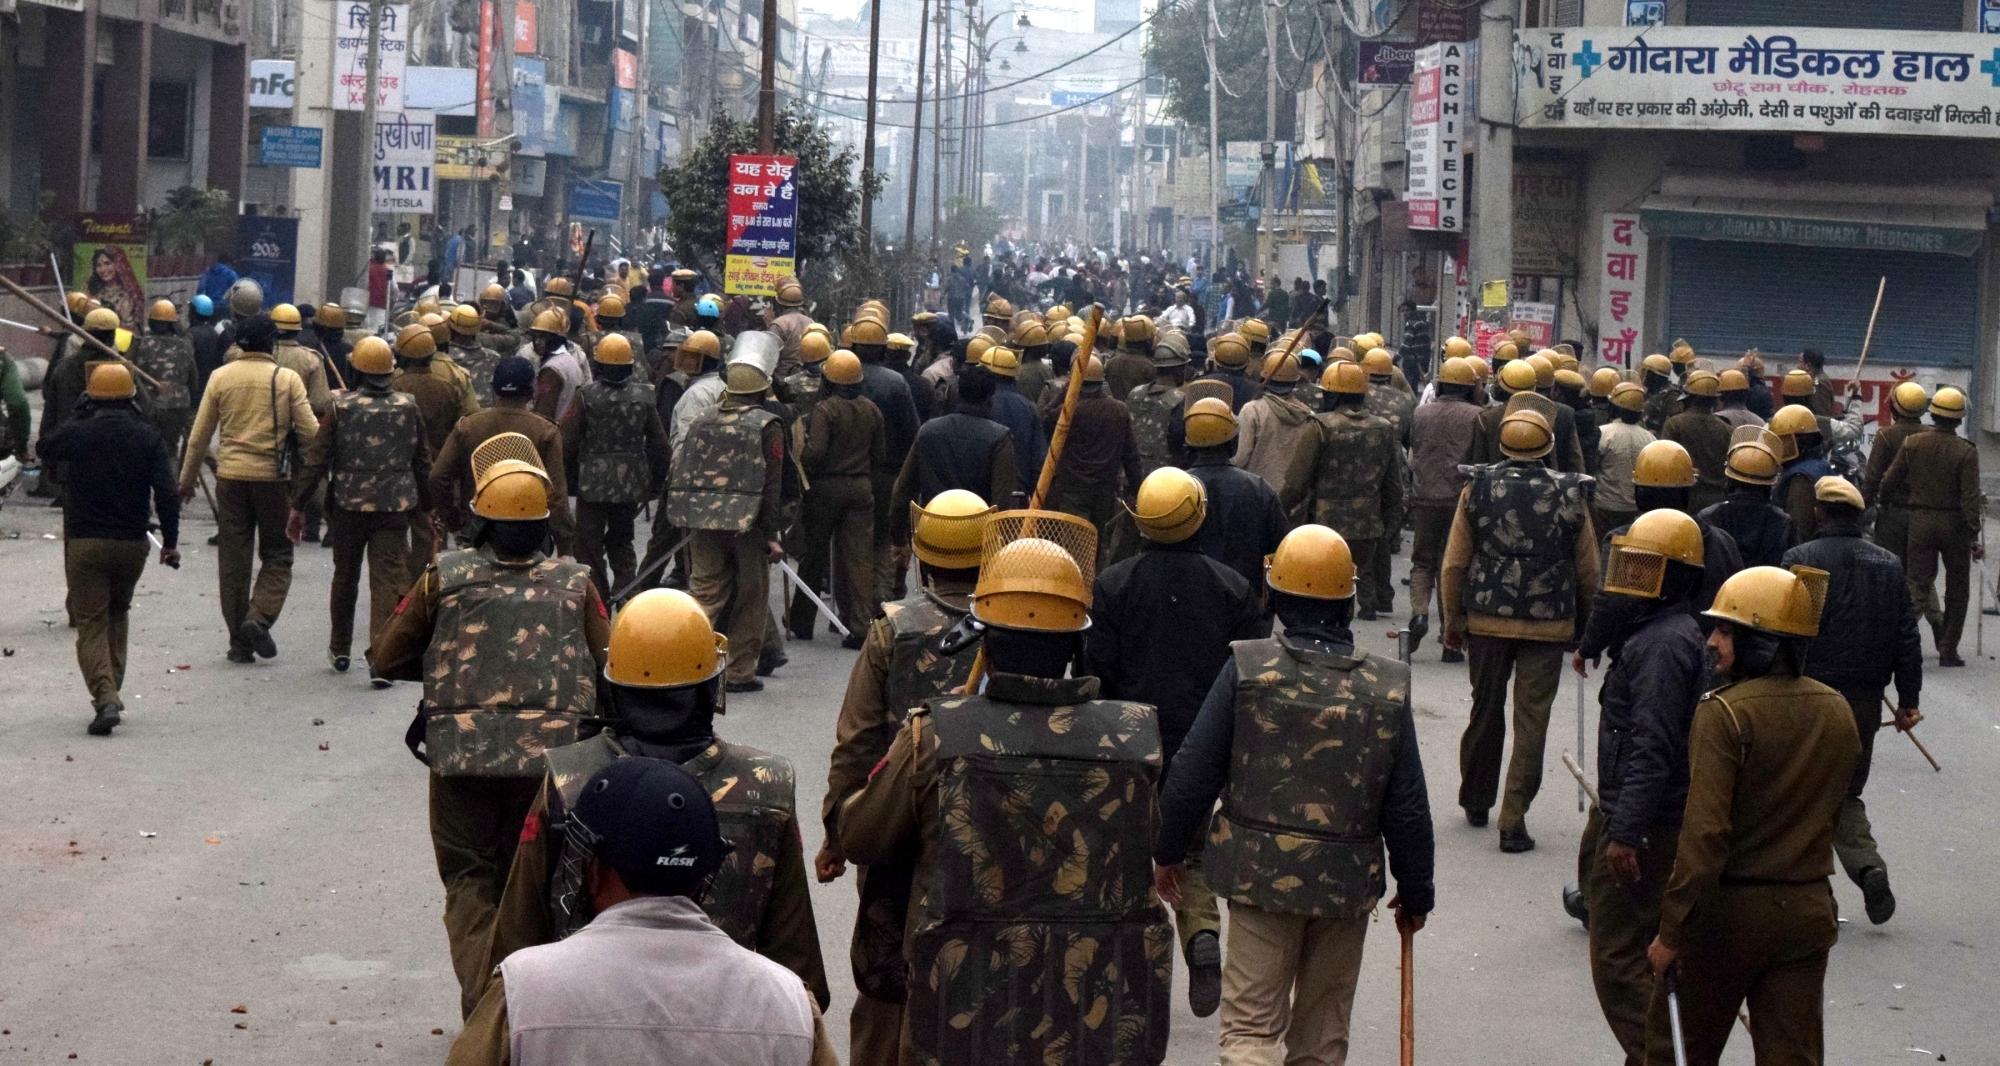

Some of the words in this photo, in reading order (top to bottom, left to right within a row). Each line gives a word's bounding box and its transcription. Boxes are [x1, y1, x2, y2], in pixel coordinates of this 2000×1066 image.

[1608, 35, 1719, 75] गोदारा
[1728, 34, 1885, 79] मैडिकल
[1892, 50, 1975, 83] हाल
[1712, 78, 1748, 97] छोटू
[1750, 82, 1781, 93] राम
[1841, 81, 1909, 96] रोहतक
[1597, 102, 1612, 116] पर
[1615, 102, 1632, 116] हर
[1637, 102, 1673, 117] प्रकार
[1676, 97, 1696, 116] की
[1759, 100, 1788, 118] देसी
[1793, 104, 1804, 118] व
[1809, 102, 1858, 126] पशुओं
[1859, 102, 1880, 120] की
[1945, 103, 1991, 125] मिलती
[266, 127, 294, 136] HOME
[1442, 45, 1460, 229] ARCHITECTS
[735, 162, 763, 176] यह
[733, 184, 760, 196] वन
[763, 181, 777, 197] वे
[780, 182, 795, 200] है
[392, 198, 423, 208] TESLA
[656, 856, 696, 867] FLASH
